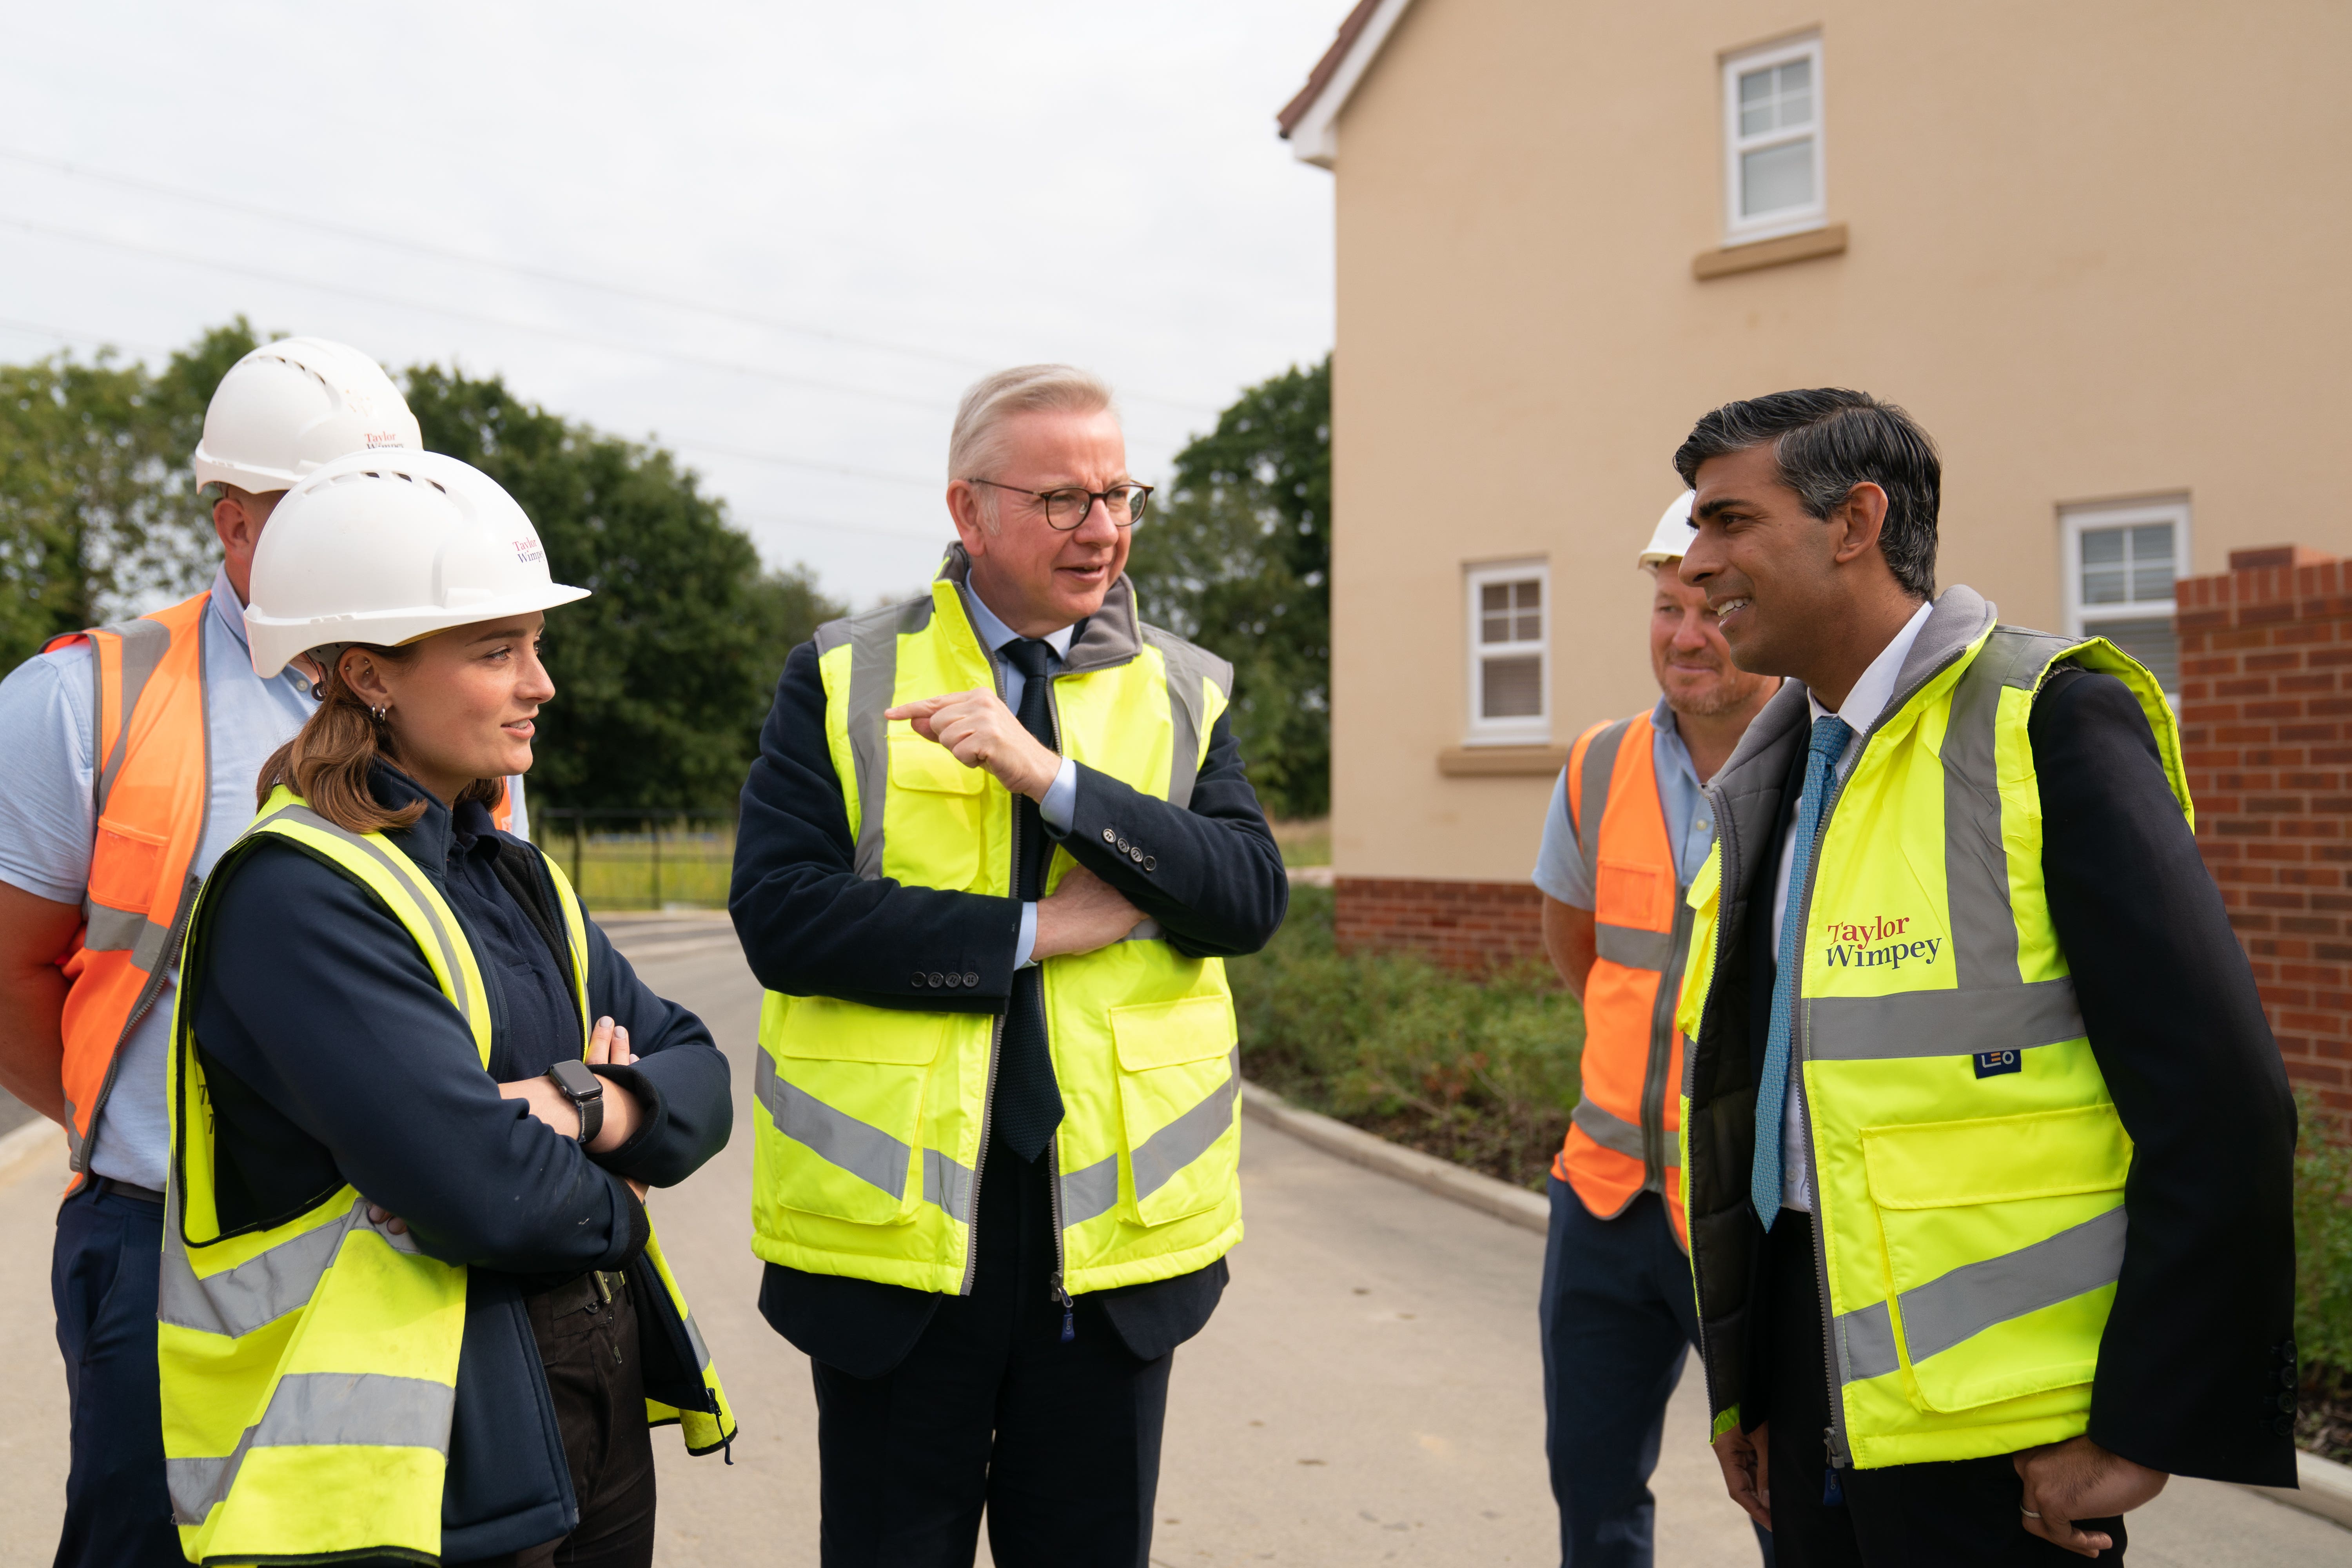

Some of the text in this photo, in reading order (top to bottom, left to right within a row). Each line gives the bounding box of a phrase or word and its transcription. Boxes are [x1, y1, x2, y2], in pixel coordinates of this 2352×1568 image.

[364, 430, 396, 443] Taylor
[512, 537, 537, 552] Taylor
[1828, 916, 1909, 950] Taylor
[1826, 938, 1942, 970] Wimpey
[1981, 1051, 2014, 1068] LEO
